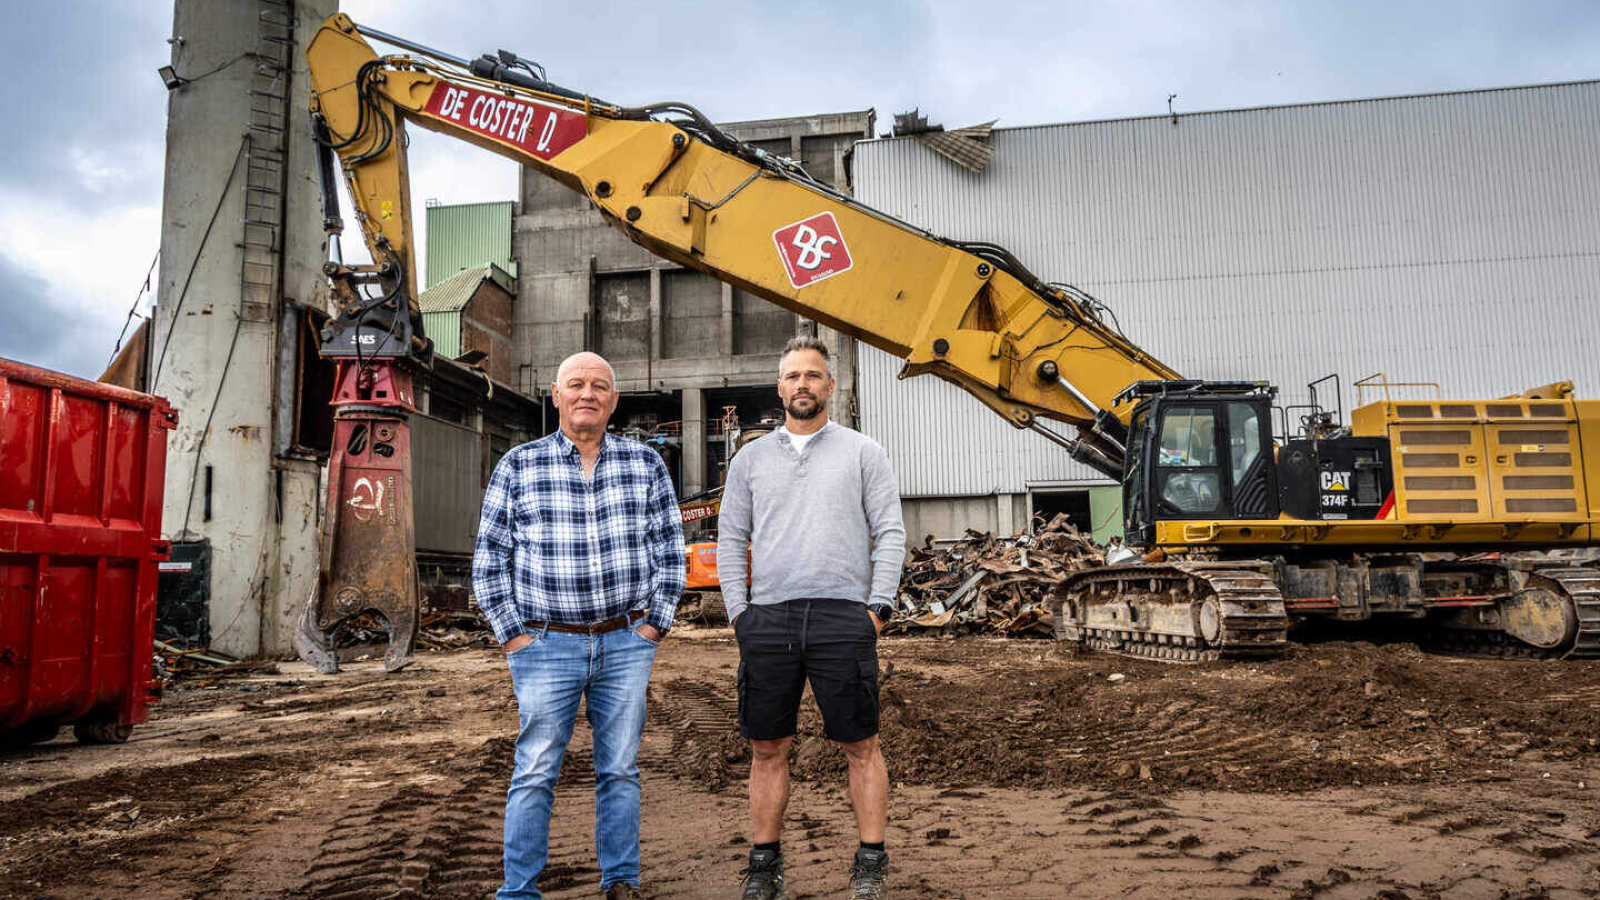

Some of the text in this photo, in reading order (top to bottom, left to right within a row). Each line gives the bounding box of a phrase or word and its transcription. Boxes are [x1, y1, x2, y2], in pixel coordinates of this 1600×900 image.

[439, 87, 557, 153] DE COSTER D.
[1320, 471, 1351, 490] CAT
[1321, 494, 1349, 507] 374F
[682, 507, 705, 521] COSTER
